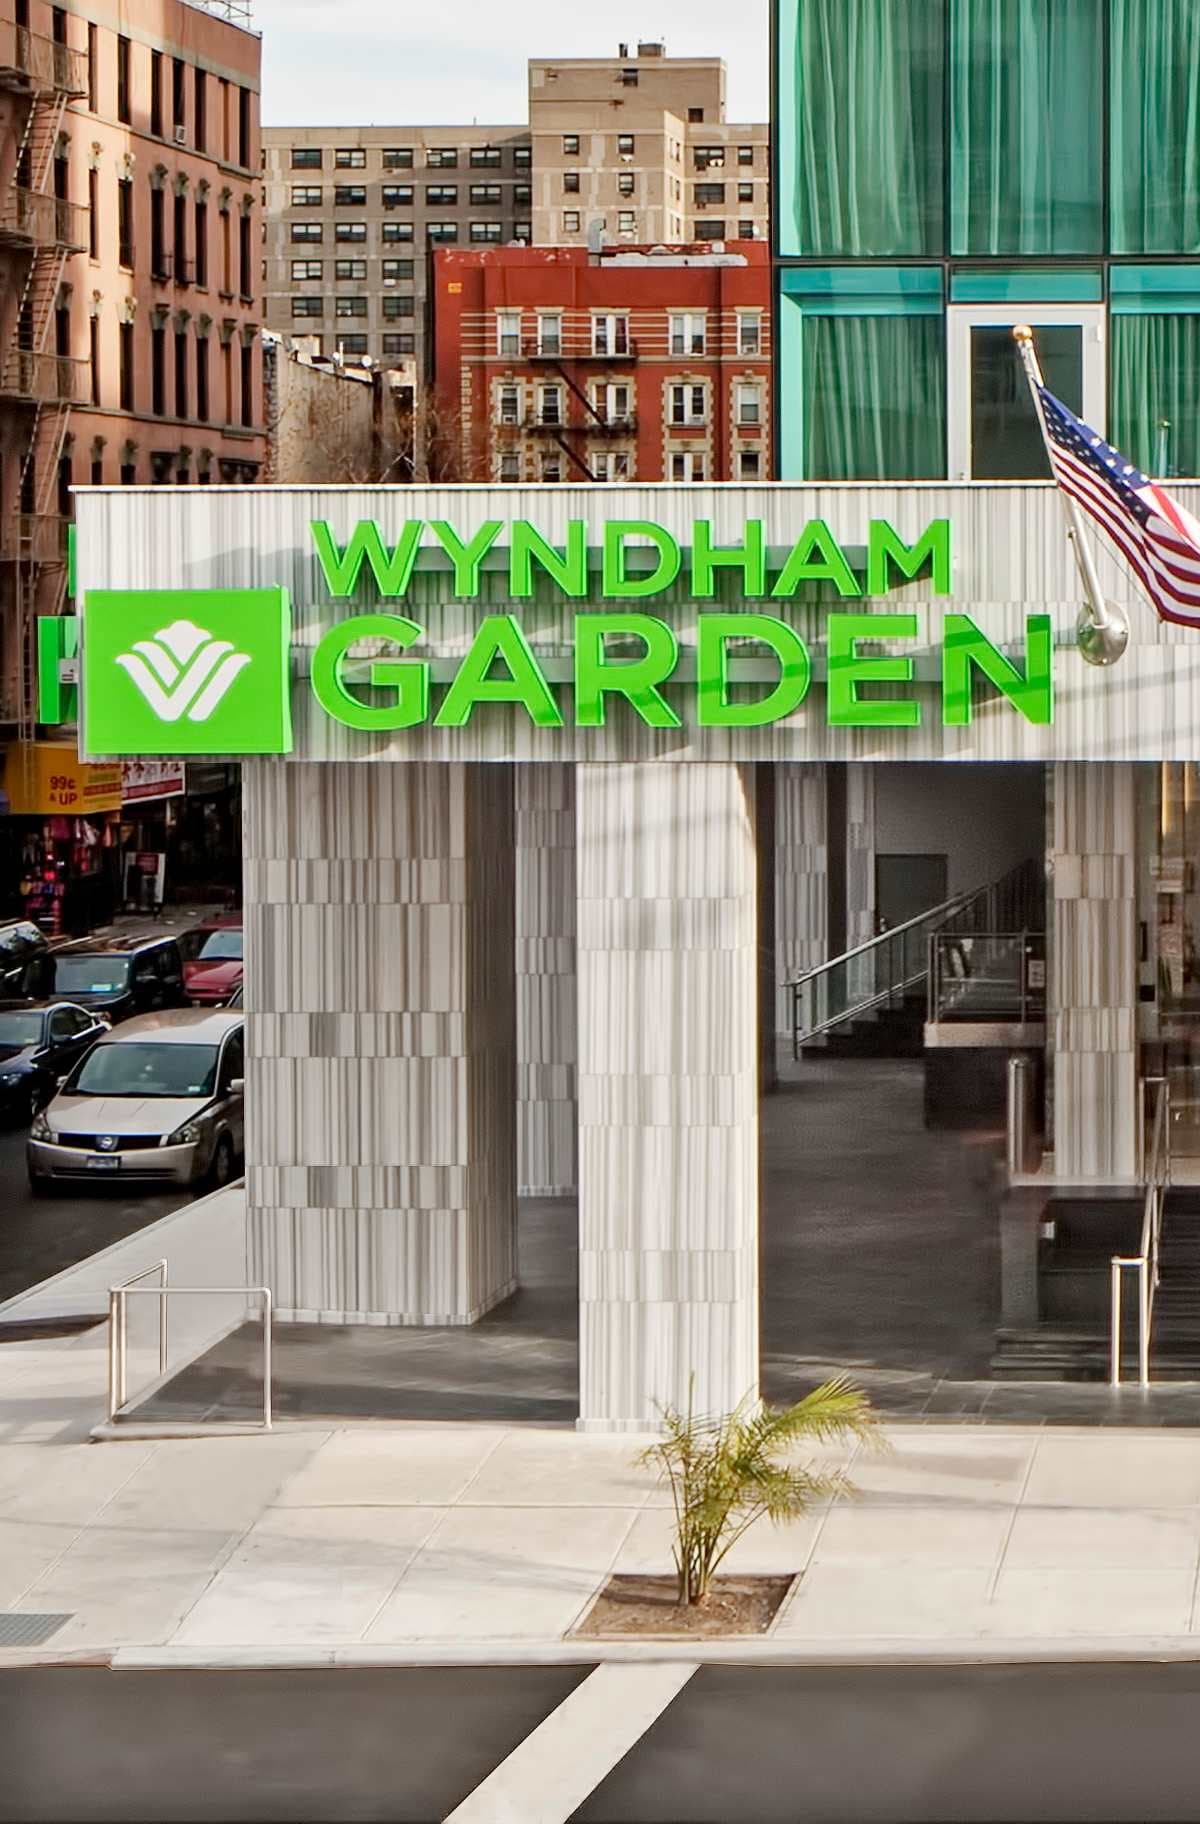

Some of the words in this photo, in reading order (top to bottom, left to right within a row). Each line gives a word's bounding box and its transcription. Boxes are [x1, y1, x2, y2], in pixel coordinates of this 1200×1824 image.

[310, 518, 952, 598] WYNDHAM
[310, 613, 1054, 732] GARDEN
[59, 792, 78, 805] UP
